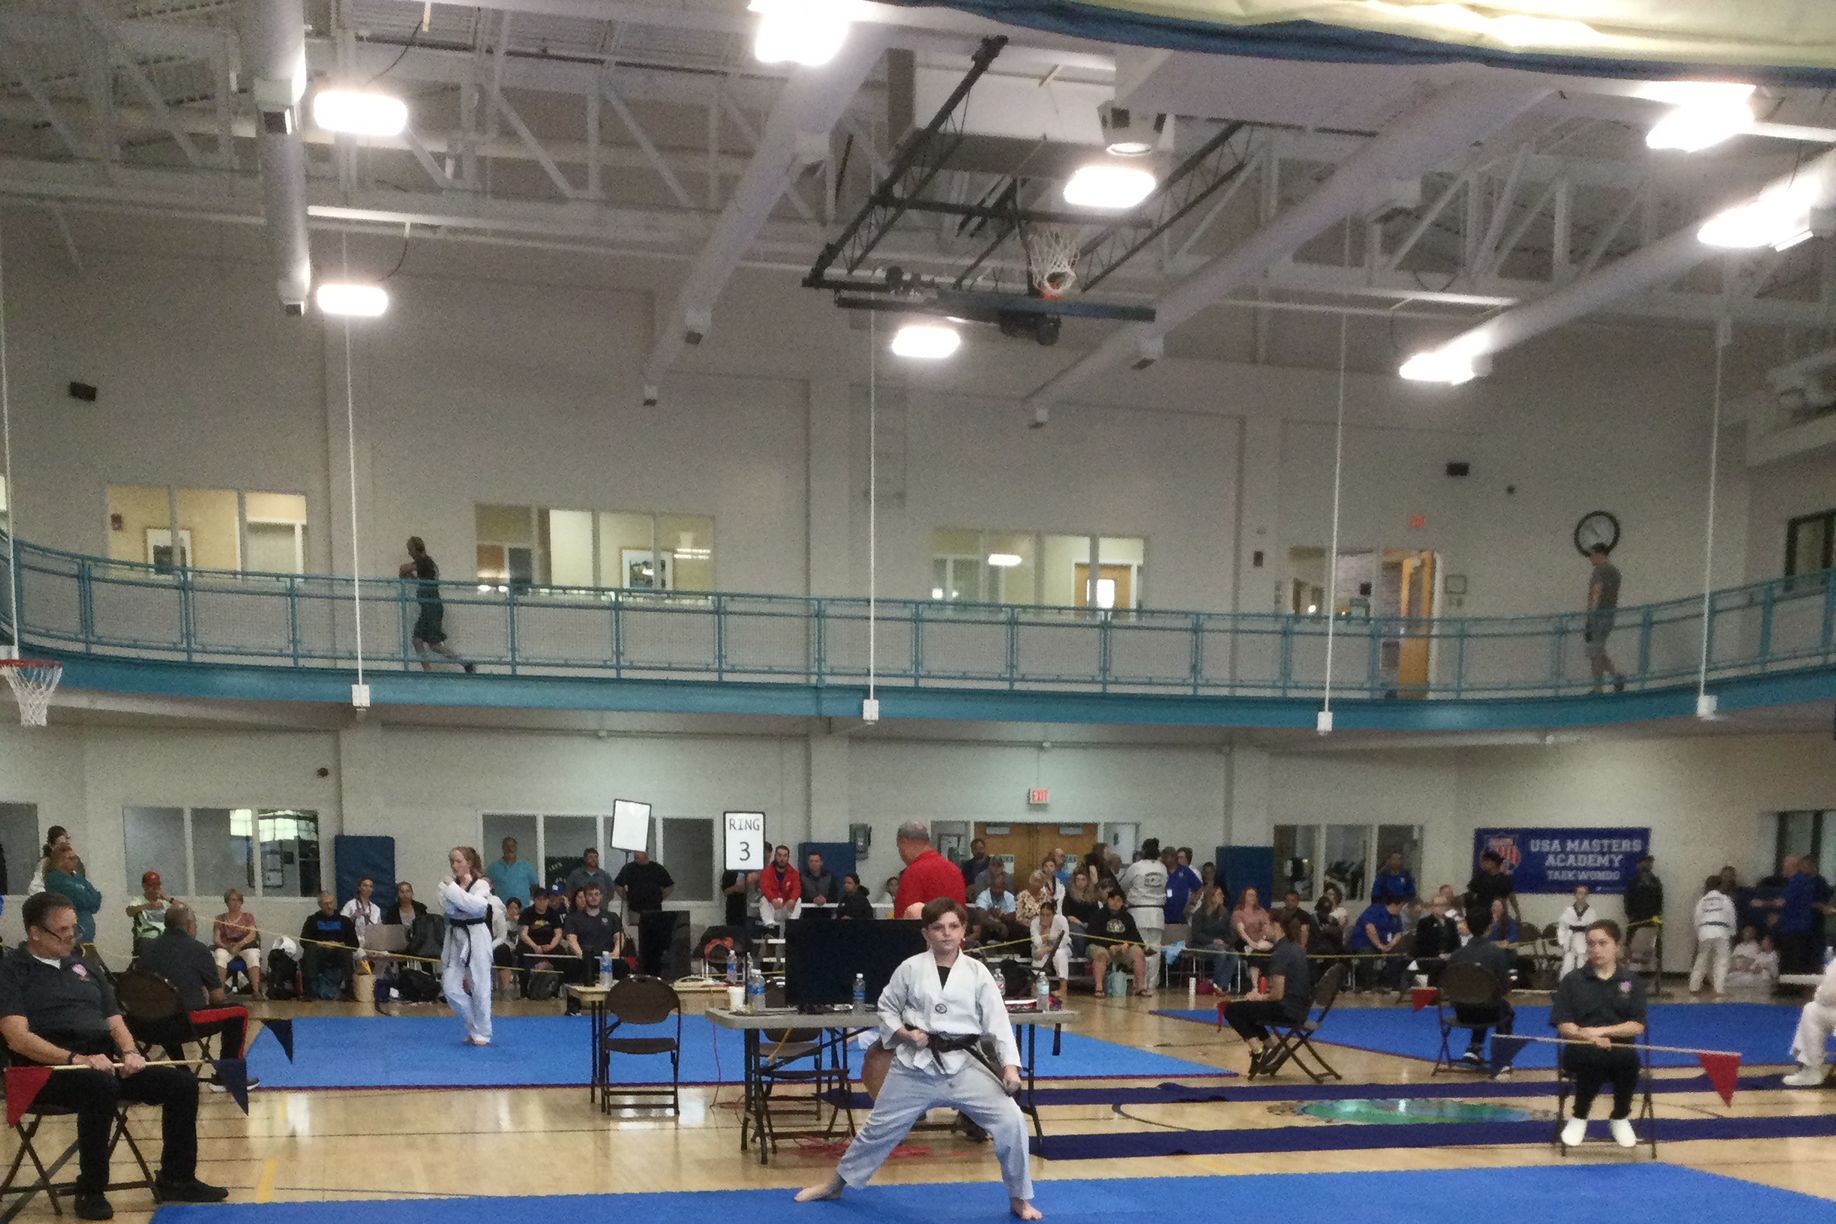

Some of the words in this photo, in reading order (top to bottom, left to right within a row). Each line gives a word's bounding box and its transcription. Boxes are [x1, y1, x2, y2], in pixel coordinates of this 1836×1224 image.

[729, 818, 760, 831] RING
[739, 841, 751, 861] 3
[1530, 839, 1561, 852] USA
[1566, 839, 1642, 852] MASTERS
[1545, 853, 1624, 867] ACADEMY
